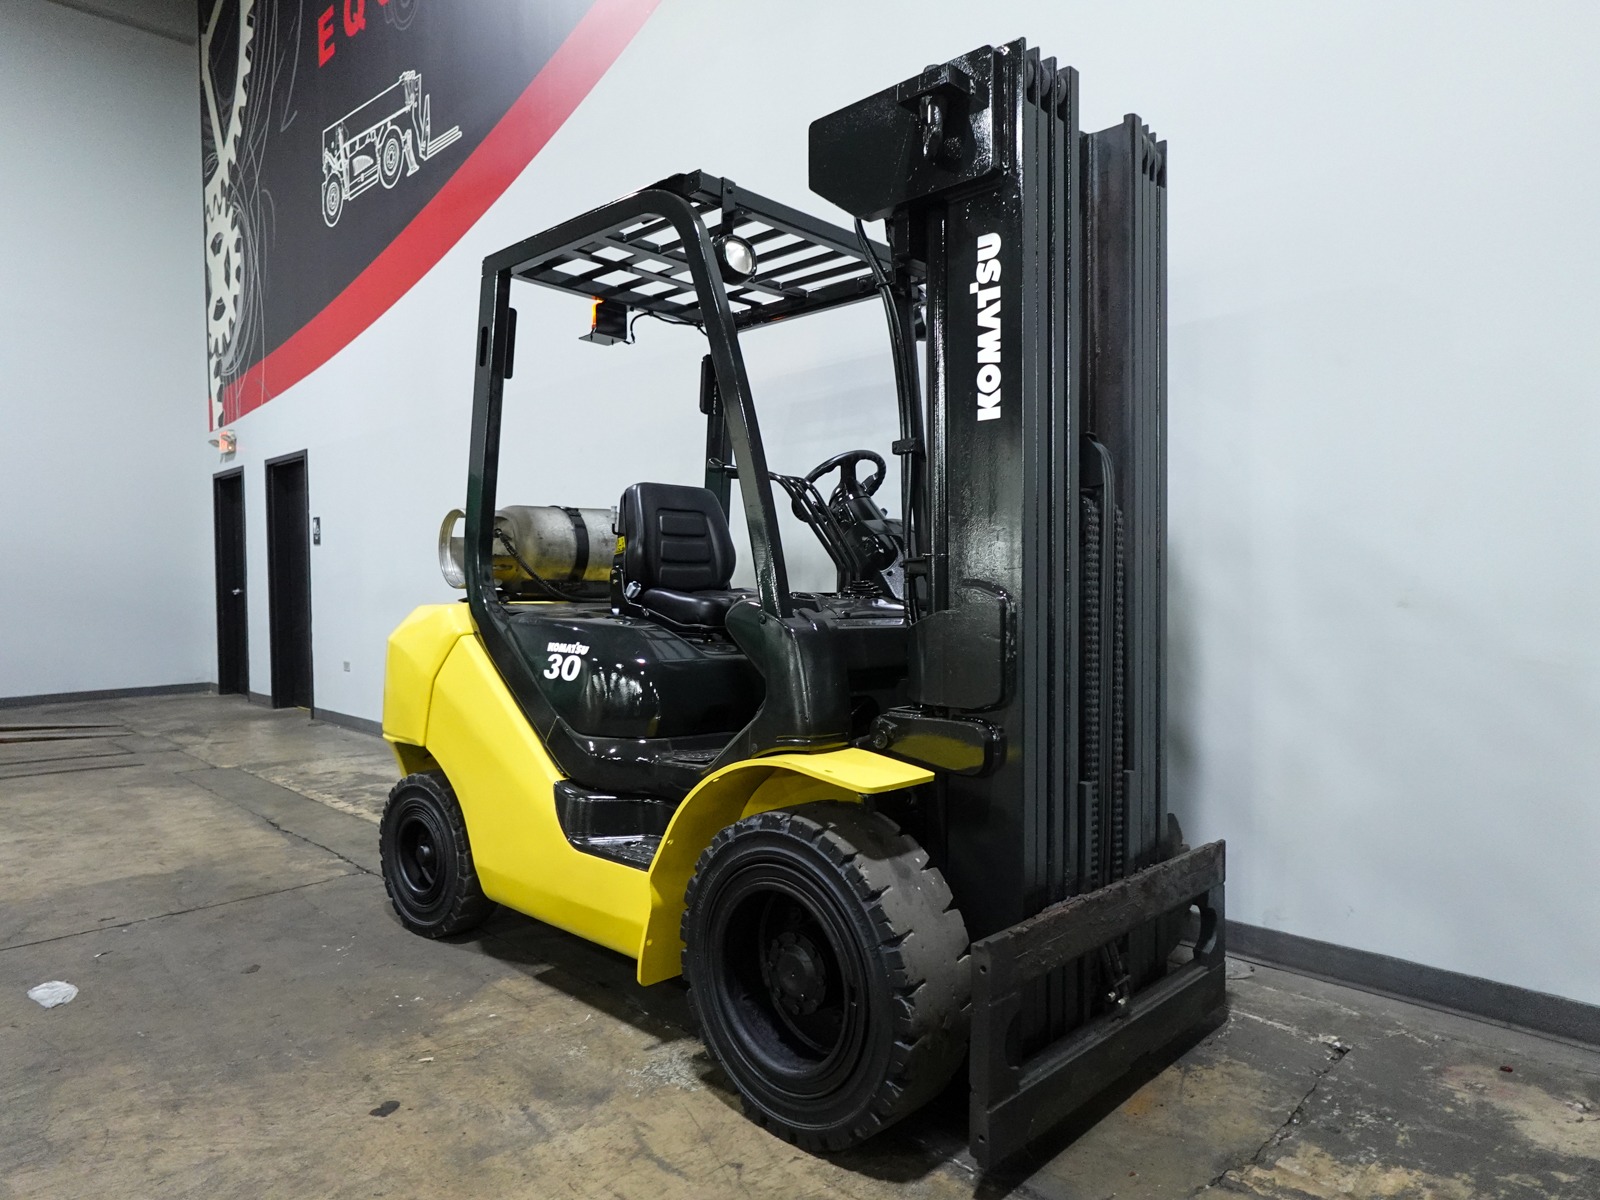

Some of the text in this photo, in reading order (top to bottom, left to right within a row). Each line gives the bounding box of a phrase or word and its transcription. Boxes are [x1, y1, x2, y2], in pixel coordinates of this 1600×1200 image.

[317, 0, 390, 67] EQ
[970, 232, 1002, 421] KOMATSU
[543, 653, 582, 682] 30
[547, 641, 590, 656] KOMATSU
